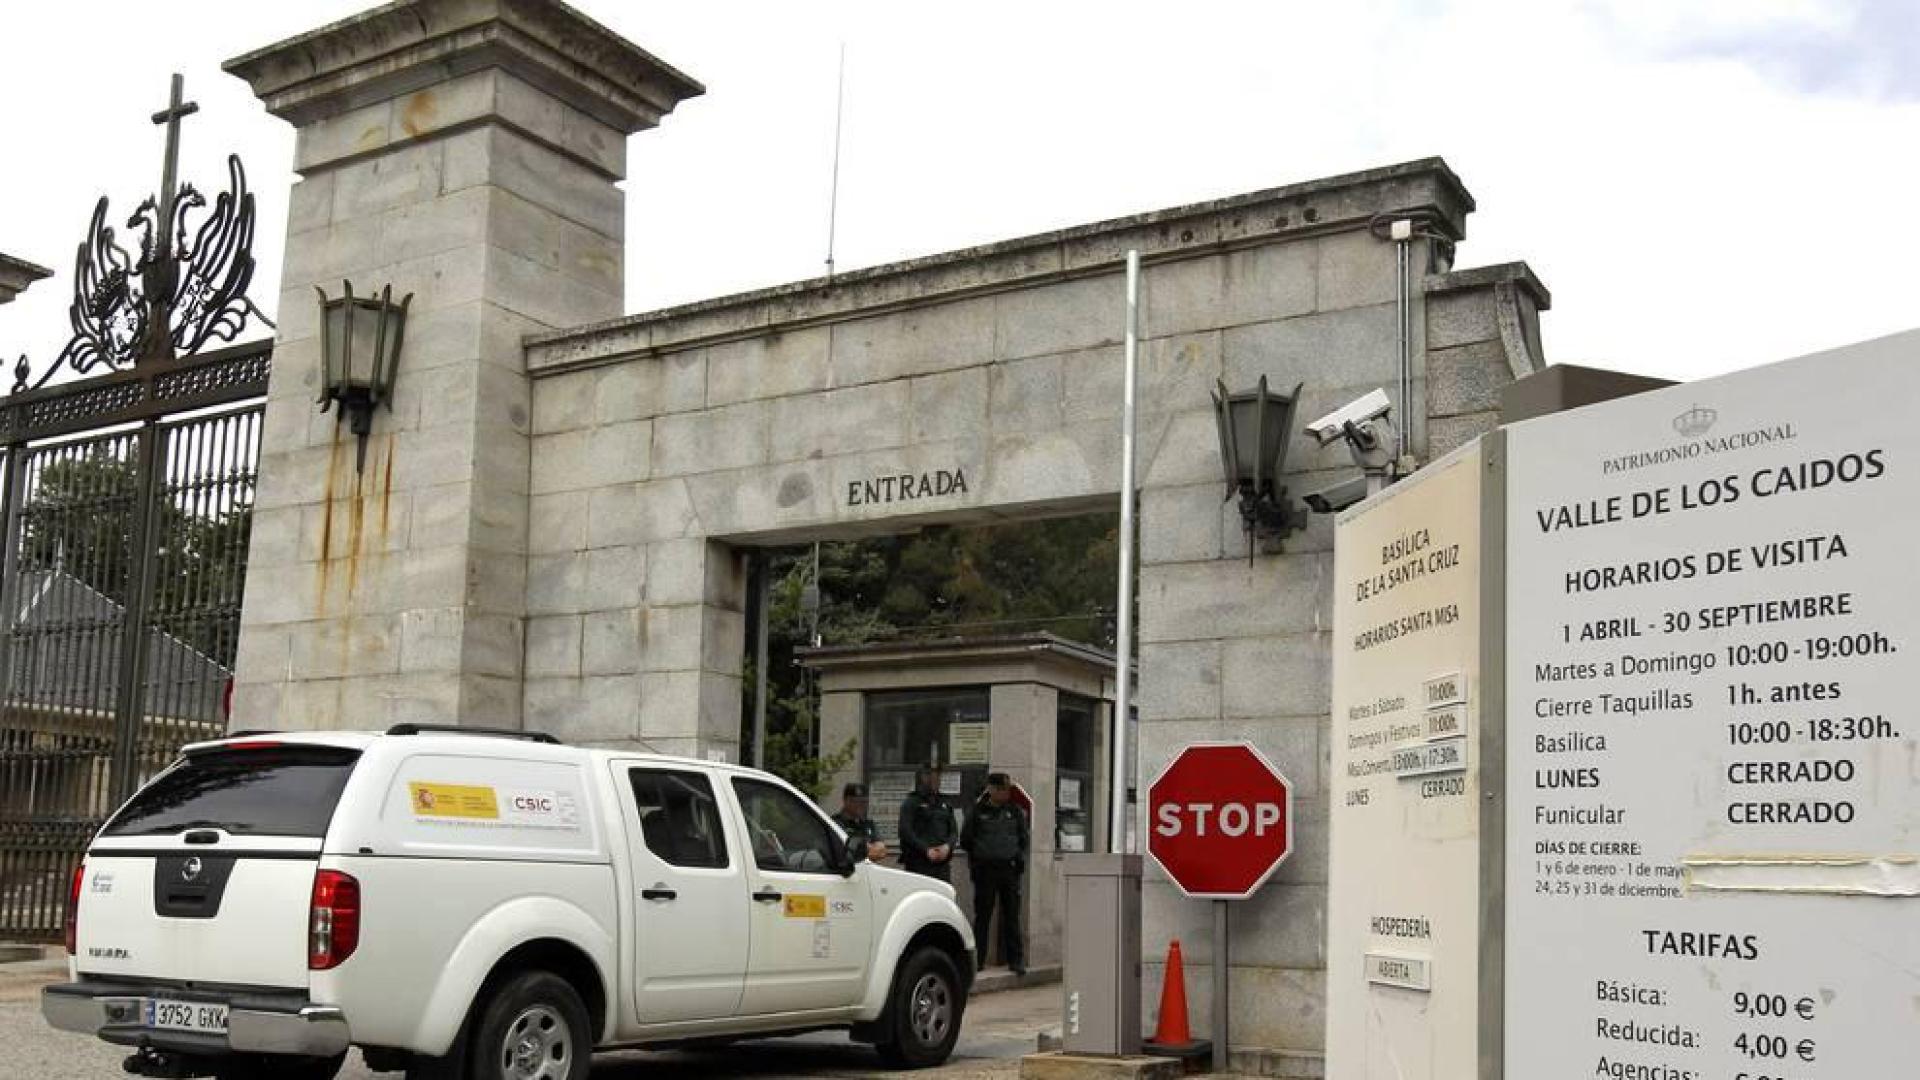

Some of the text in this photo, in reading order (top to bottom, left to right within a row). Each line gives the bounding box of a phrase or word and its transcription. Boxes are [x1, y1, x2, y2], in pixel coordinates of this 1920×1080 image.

[1603, 423, 1797, 475] PATRIMONIO NACIONAL
[848, 467, 968, 506] ENTRADA
[1537, 449, 1885, 533] VALLE DE LOS CAIDOS
[1382, 528, 1430, 565] BASÍLICA
[1566, 534, 1847, 593] HORARIOS DE VISITA
[1356, 544, 1459, 602] DE LA SANTA CRUZ
[1354, 604, 1459, 651] HORARIOS SANTA MISA
[1563, 625, 1571, 643] 1
[1580, 618, 1642, 642] ABRIL
[1663, 612, 1690, 633] 30
[1699, 593, 1852, 629] SEPTIEMBRE
[1535, 661, 1597, 683] Martes
[1603, 661, 1615, 677] a
[1621, 650, 1716, 677] Domingo
[1727, 641, 1788, 667] 10:00
[1535, 680, 1841, 718] Cierre Taquillas 1h. antes
[1535, 732, 1607, 753] Basilica
[1728, 721, 1791, 745] 10:00
[1535, 759, 1855, 788] LUNES CERRADO
[515, 796, 552, 812] CSIC
[1346, 777, 1465, 806] LUNES CERRADO
[1157, 803, 1280, 837] STOP
[1535, 801, 1855, 825] Funicular CERRADO
[1535, 840, 1642, 855] DÍAS DE CIERRE:
[1545, 864, 1552, 876] y
[1555, 861, 1563, 874] 6
[1565, 861, 1580, 875] de
[1582, 864, 1616, 875] enero
[1636, 863, 1650, 876] de
[1556, 881, 1570, 895] 25
[1573, 884, 1581, 896] y
[1584, 882, 1597, 895] 31
[1600, 882, 1614, 896] de
[1371, 915, 1431, 939] HOSPEDERÍA
[1643, 929, 1758, 960] TARIFAS
[159, 1004, 193, 1027] 3752
[1597, 980, 1815, 1020] Básica: 9,00 €
[1597, 1018, 1816, 1062] Reducida: 4,00 €
